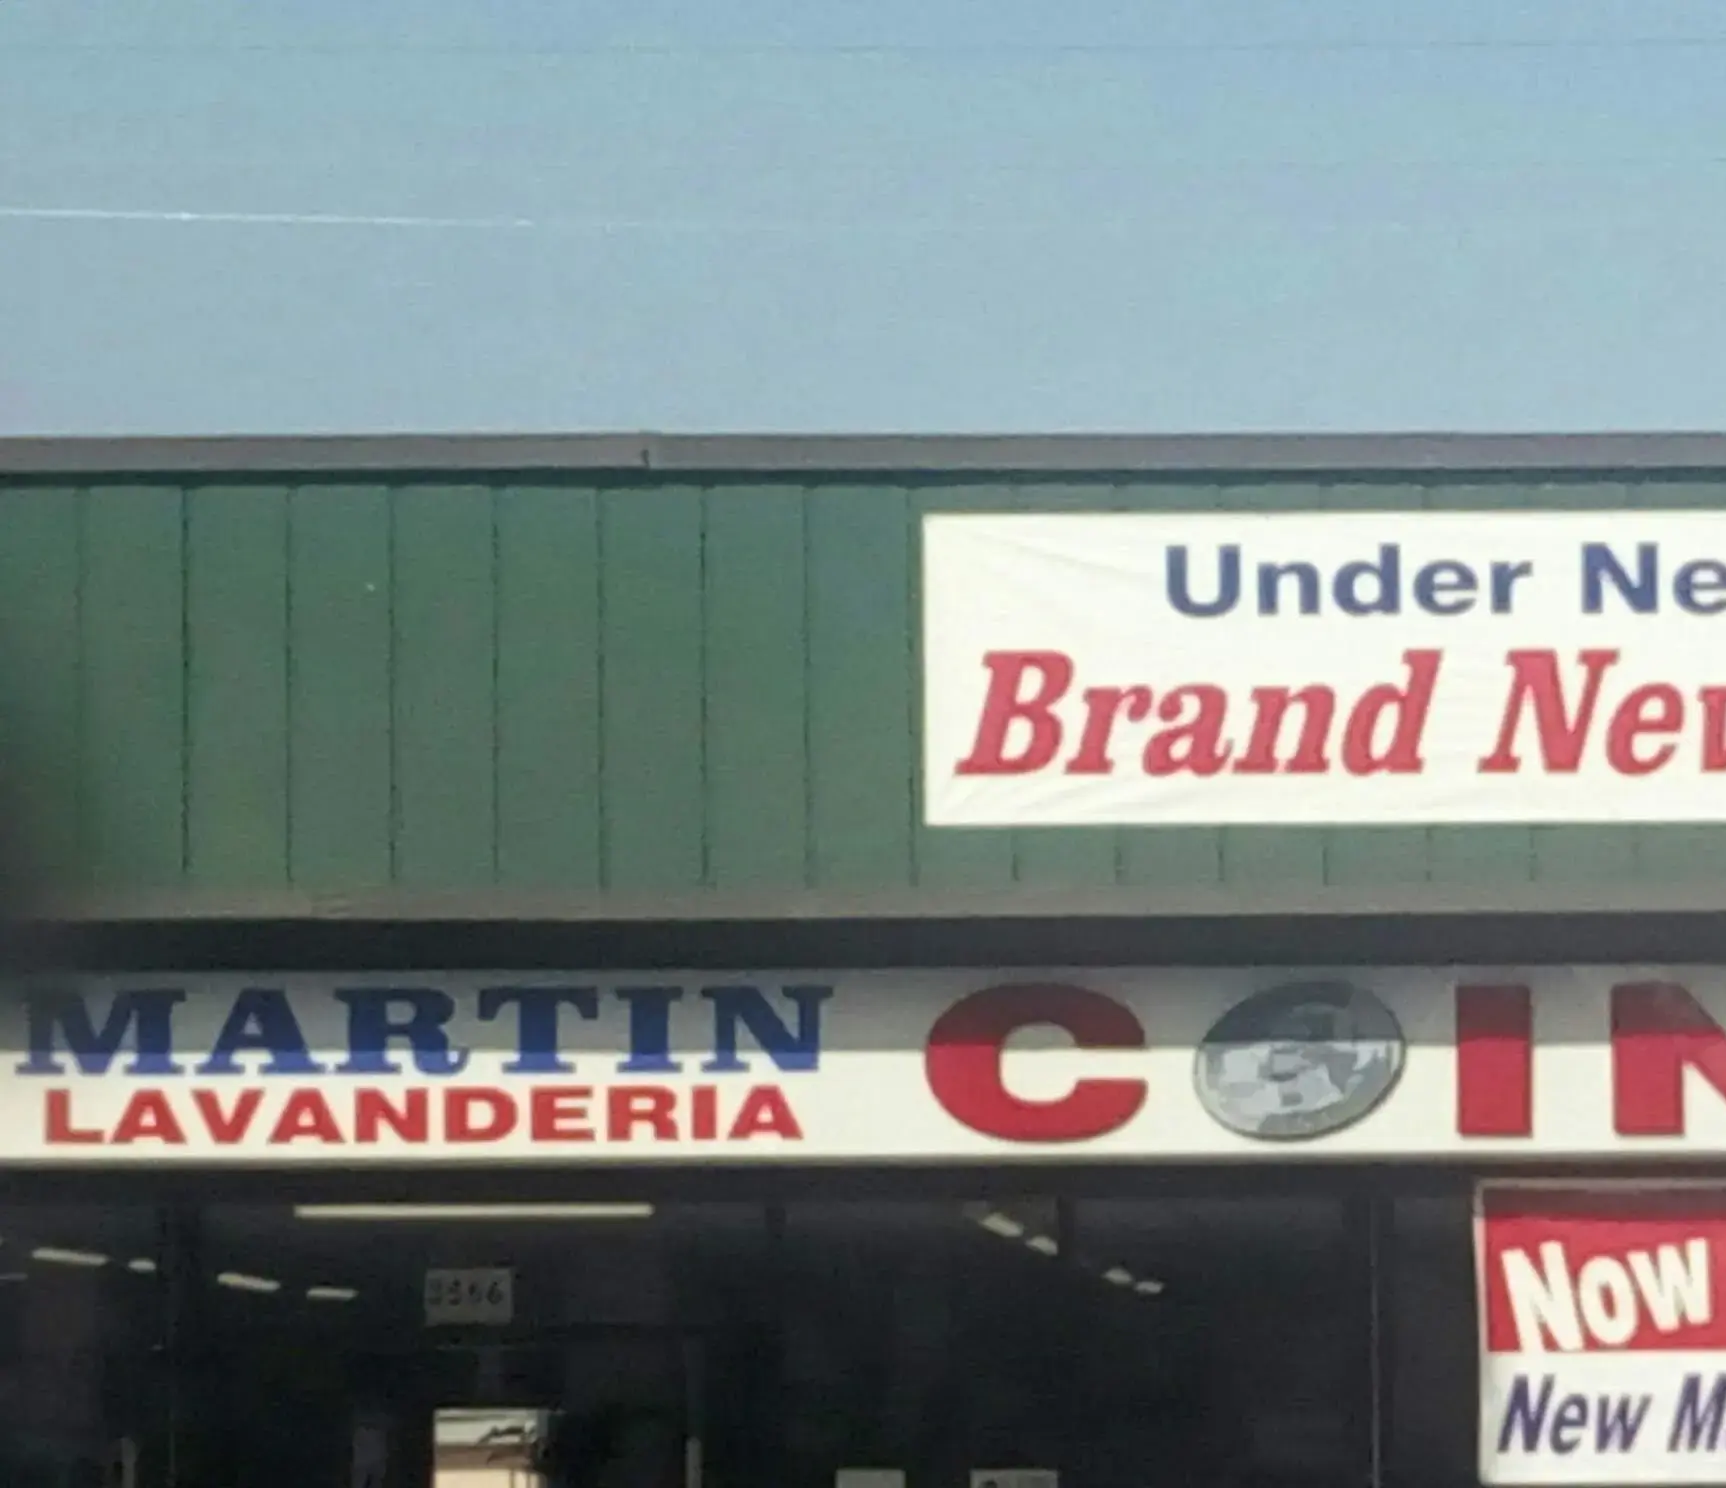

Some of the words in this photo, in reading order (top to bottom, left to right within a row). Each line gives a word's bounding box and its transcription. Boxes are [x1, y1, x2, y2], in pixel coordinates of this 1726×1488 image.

[1163, 543, 1532, 617] Under
[955, 647, 1443, 777] Brand
[14, 985, 834, 1076] MARTIN
[45, 1085, 804, 1145] LAVANDERIA
[1501, 1238, 1711, 1352] Now
[1497, 1374, 1651, 1454] New
